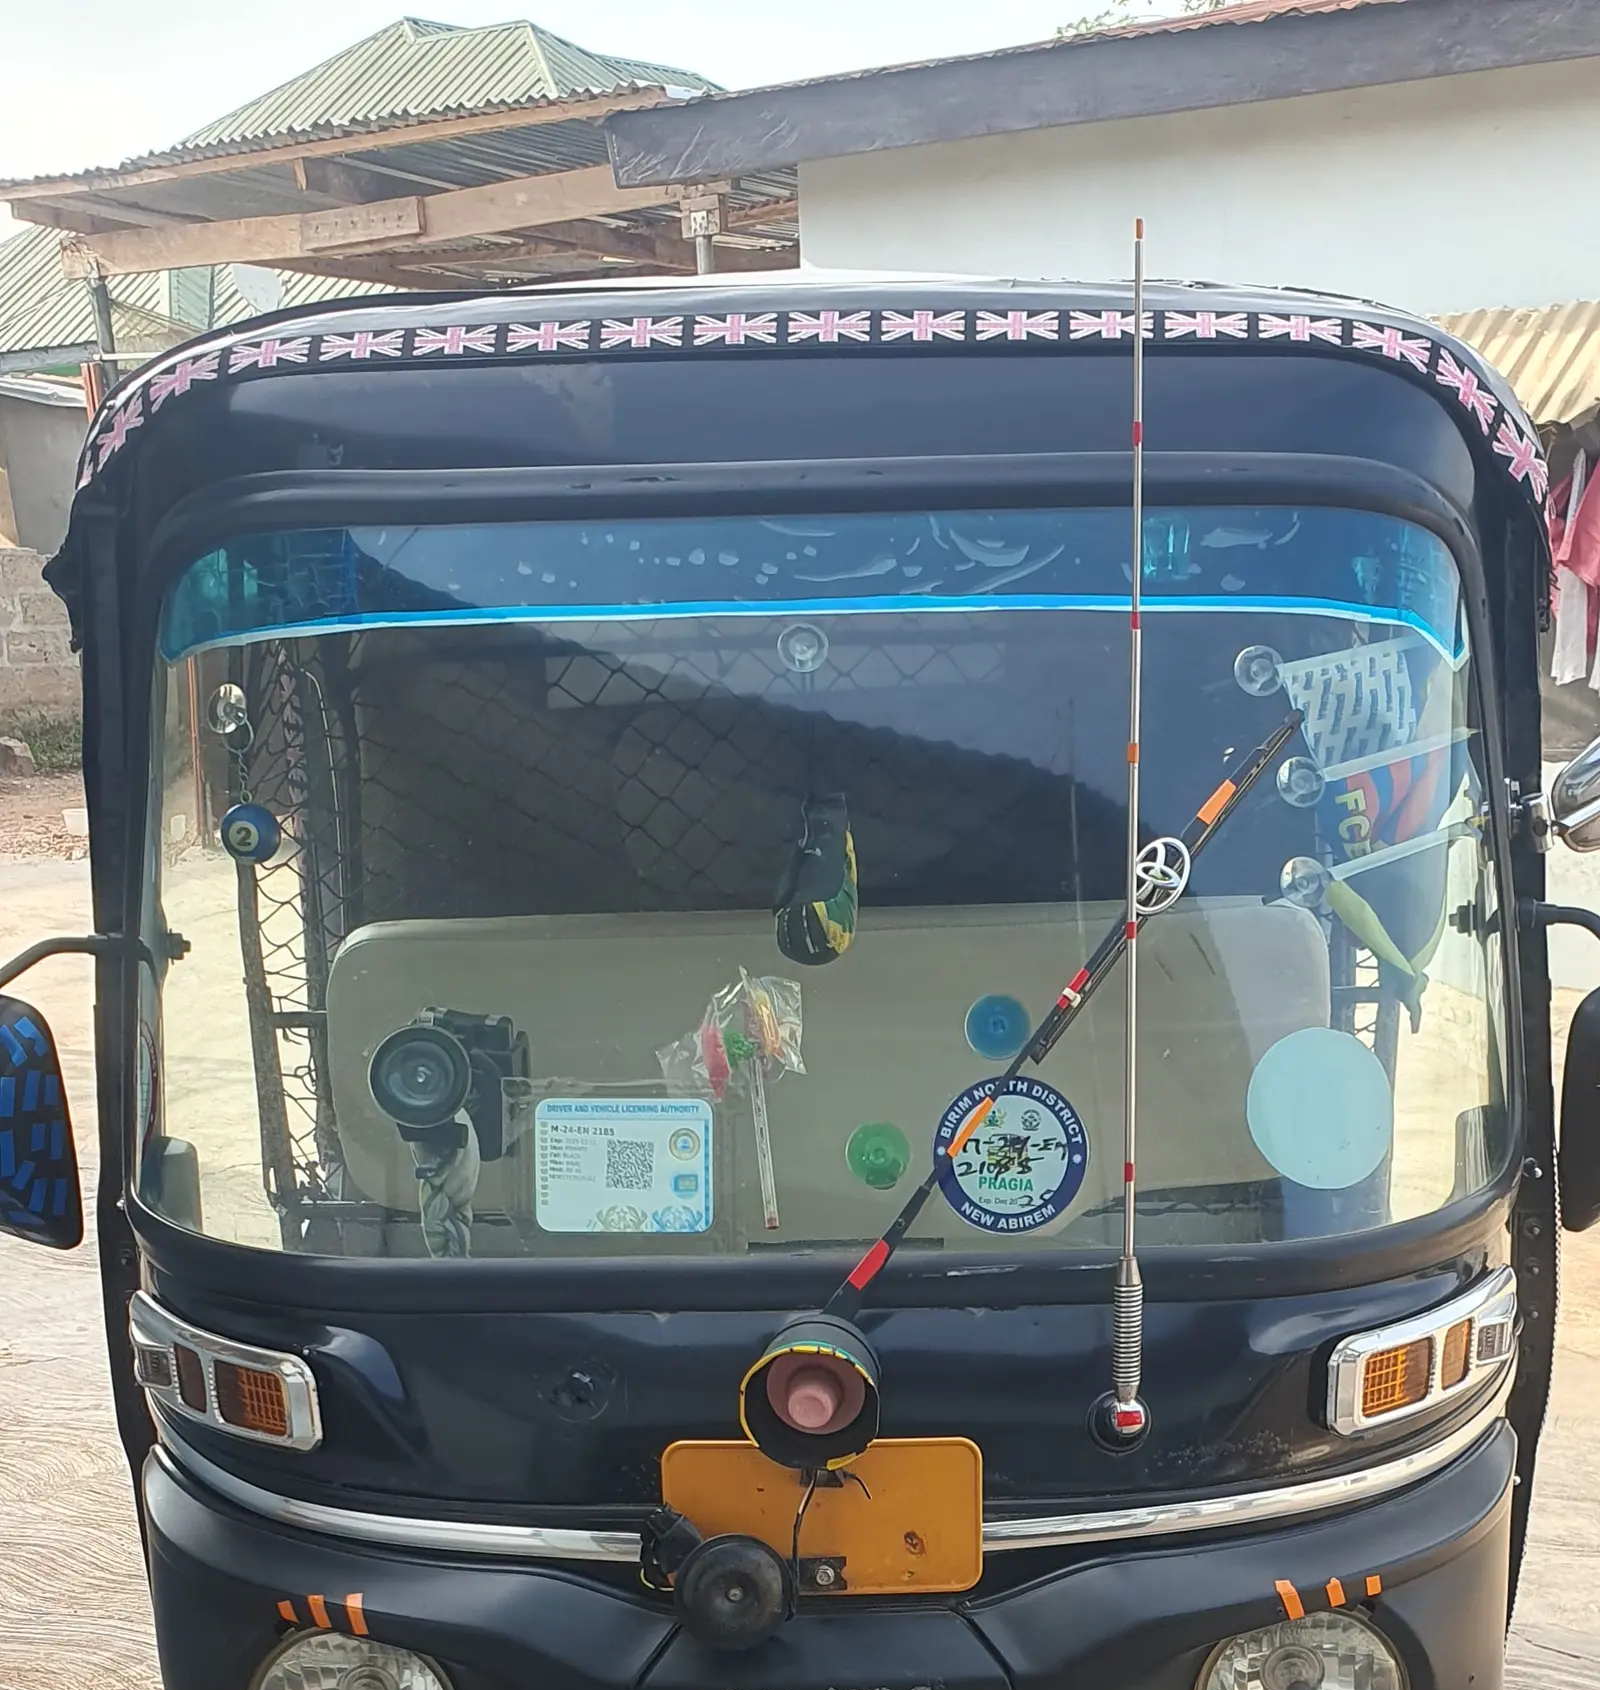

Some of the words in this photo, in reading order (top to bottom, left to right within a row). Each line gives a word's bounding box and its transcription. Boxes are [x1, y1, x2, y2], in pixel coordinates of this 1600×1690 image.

[236, 826, 252, 847] 2
[547, 1104, 572, 1113] DRIVER
[574, 1104, 589, 1113] AND
[591, 1104, 620, 1114] VEHICLE
[621, 1104, 658, 1114] LICENSING
[660, 1104, 700, 1114] AUTHORITY
[940, 1096, 972, 1139] BIRIM
[973, 1080, 1028, 1101] NOTH
[1032, 1085, 1083, 1144] DISTRICT
[551, 1125, 590, 1135] M-24-EN
[592, 1126, 615, 1136] 2185
[978, 1176, 1034, 1192] PRAGIA
[961, 1201, 995, 1227] NEW
[997, 1203, 1056, 1229] ABIREM
